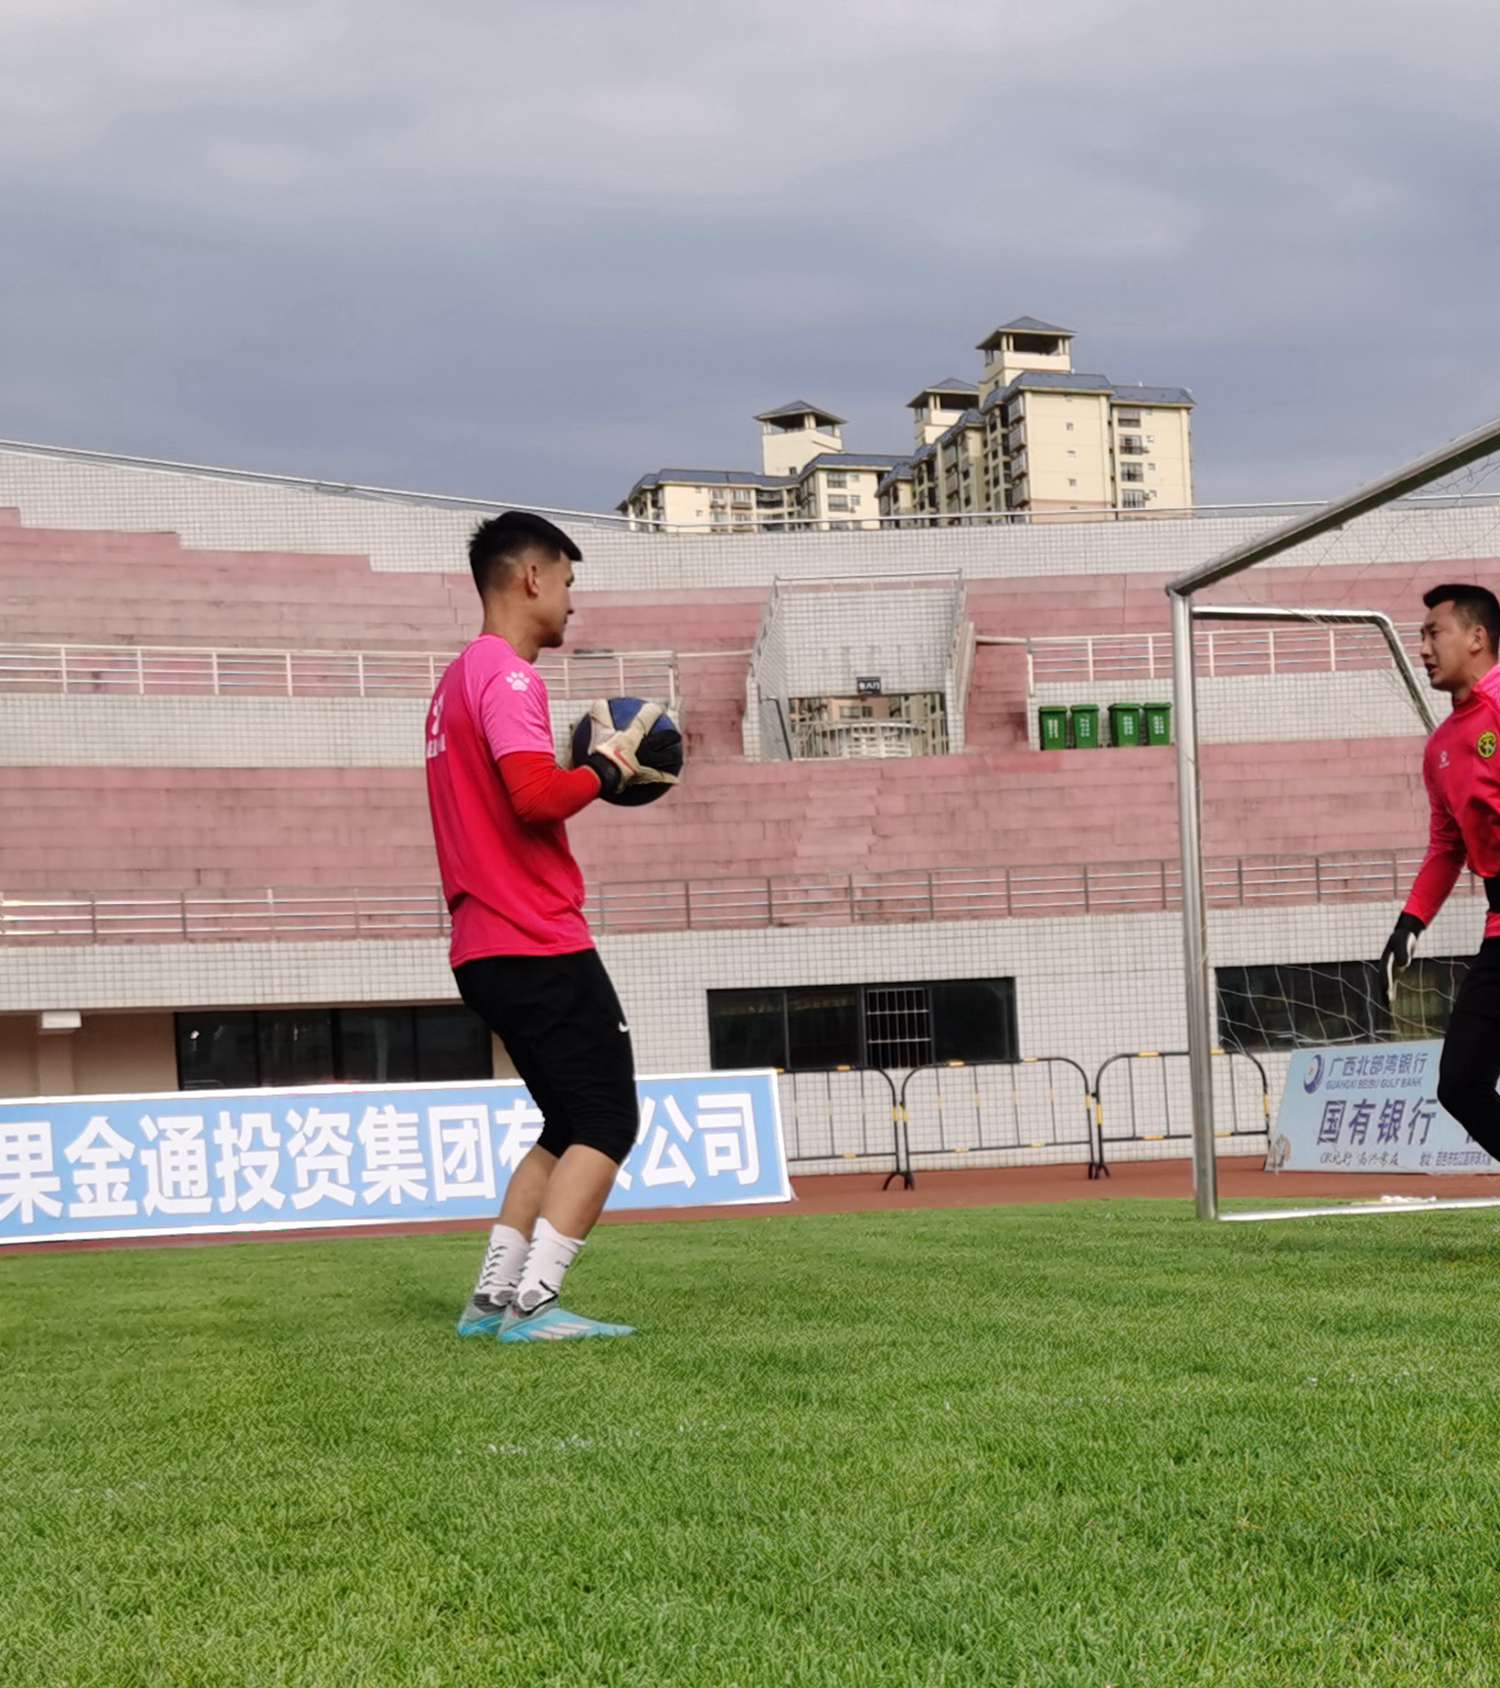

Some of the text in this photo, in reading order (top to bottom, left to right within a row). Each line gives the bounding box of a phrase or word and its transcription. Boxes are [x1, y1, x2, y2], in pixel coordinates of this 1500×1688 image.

[1328, 1053, 1428, 1077] 广西北部湾银行
[1316, 1096, 1438, 1146] 国有银行
[0, 1093, 760, 1224] 果金通投资集团有公司
